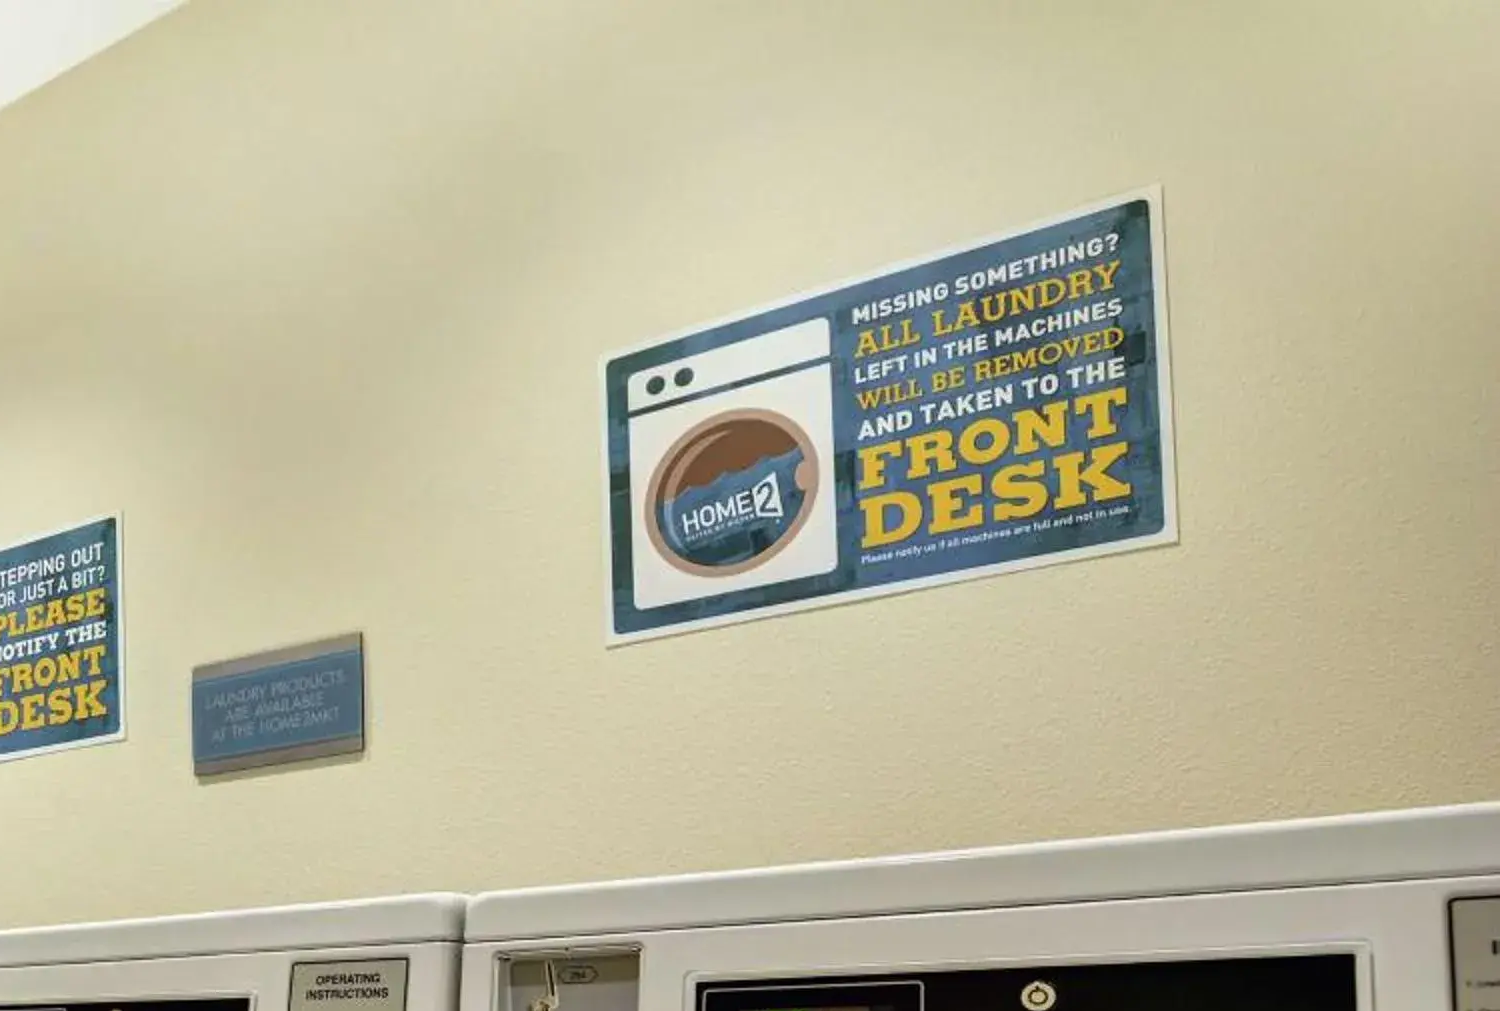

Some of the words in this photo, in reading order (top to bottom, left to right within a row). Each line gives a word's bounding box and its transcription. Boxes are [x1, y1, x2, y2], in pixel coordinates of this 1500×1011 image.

[852, 282, 949, 325] MISSING
[954, 233, 1119, 295] SOMETHING?
[854, 318, 921, 358] ALL
[932, 259, 1121, 337] LAUNDRY
[854, 355, 908, 385] LEFT
[914, 348, 937, 368] IN
[943, 333, 988, 359] THE
[994, 297, 1124, 347] MACHINES
[857, 379, 924, 411] WILL
[931, 366, 967, 393] BE
[974, 326, 1125, 383] REMOVED
[857, 411, 913, 441] AND
[919, 385, 1013, 425] TAKEN
[1021, 374, 1059, 399] TO
[1066, 356, 1126, 387] THE
[858, 387, 1128, 491] FRONT
[858, 441, 1132, 549] DESK
[1053, 514, 1074, 528] and
[1075, 511, 1093, 522] not
[71, 542, 104, 568] OUT
[20, 579, 55, 603] JUST
[58, 578, 69, 593] A
[72, 565, 105, 589] BIT?
[65, 620, 107, 646] THE
[204, 683, 267, 710] LAUNDRY
[270, 669, 345, 695] PRODUCTS
[226, 706, 248, 721] ARE
[255, 692, 325, 716] AVAILABLE
[212, 728, 226, 742] AT
[232, 722, 255, 739] THE
[305, 987, 389, 1001] INSTRUCTIONS
[315, 973, 381, 986] OPERATING
